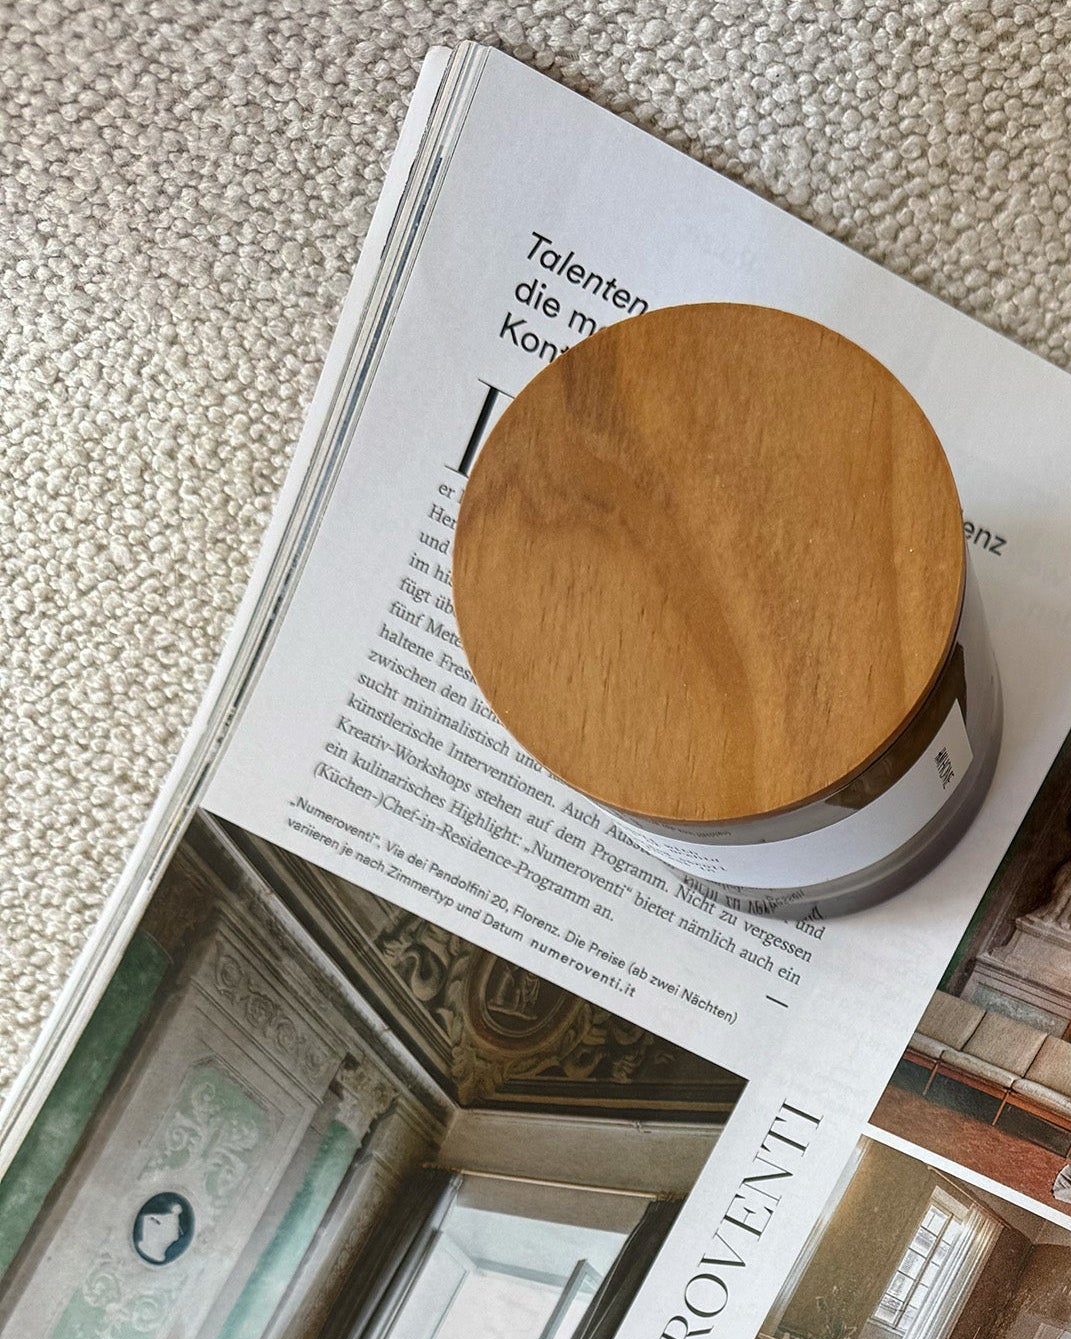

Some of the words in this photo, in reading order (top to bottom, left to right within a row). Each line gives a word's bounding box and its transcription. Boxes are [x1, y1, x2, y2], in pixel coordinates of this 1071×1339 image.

[527, 231, 649, 315] Talenten
[515, 279, 561, 318] die
[568, 310, 605, 336] m
[409, 552, 430, 574] im
[419, 532, 450, 555] und
[388, 601, 425, 627] fünf
[399, 577, 432, 603] fügt
[435, 595, 457, 617] üb
[378, 622, 434, 662] haltene
[367, 649, 437, 693] zwischen
[440, 684, 467, 707] den
[356, 673, 400, 701] sucht
[402, 696, 510, 757] minimalistisch
[335, 715, 472, 793] Kreativ-Workshops
[474, 788, 522, 819] stehen
[525, 814, 554, 833] auf
[554, 826, 586, 851] dem
[590, 841, 668, 893] Programm.
[674, 884, 717, 915] Nicht
[718, 910, 738, 926] zu
[744, 920, 812, 963] vergessen
[346, 692, 444, 751] künstlerische
[446, 741, 555, 808] Interventionen.
[559, 801, 600, 830] Auch
[795, 919, 826, 941] und
[324, 741, 348, 760] ein
[351, 750, 446, 808] kulinarisches
[447, 799, 523, 846] Highlight:
[633, 891, 676, 923] bietet
[677, 917, 736, 953] nämlich
[738, 948, 774, 972] auch
[777, 967, 801, 986] ein
[287, 818, 339, 849] variieren
[339, 842, 352, 856] je
[354, 852, 384, 872] nach
[386, 864, 454, 906] Zimmertyp
[455, 902, 482, 920] und
[481, 912, 524, 942] Datum
[529, 938, 636, 998] numeroventi.it
[386, 840, 404, 858] Via
[406, 853, 428, 869] dei
[428, 861, 491, 901] Pandolfini
[563, 929, 586, 949] Die
[587, 941, 626, 969] Preise
[627, 961, 648, 980] (ab
[649, 975, 681, 996] zwei
[680, 988, 738, 1025] Nächten)
[592, 903, 614, 922] an.
